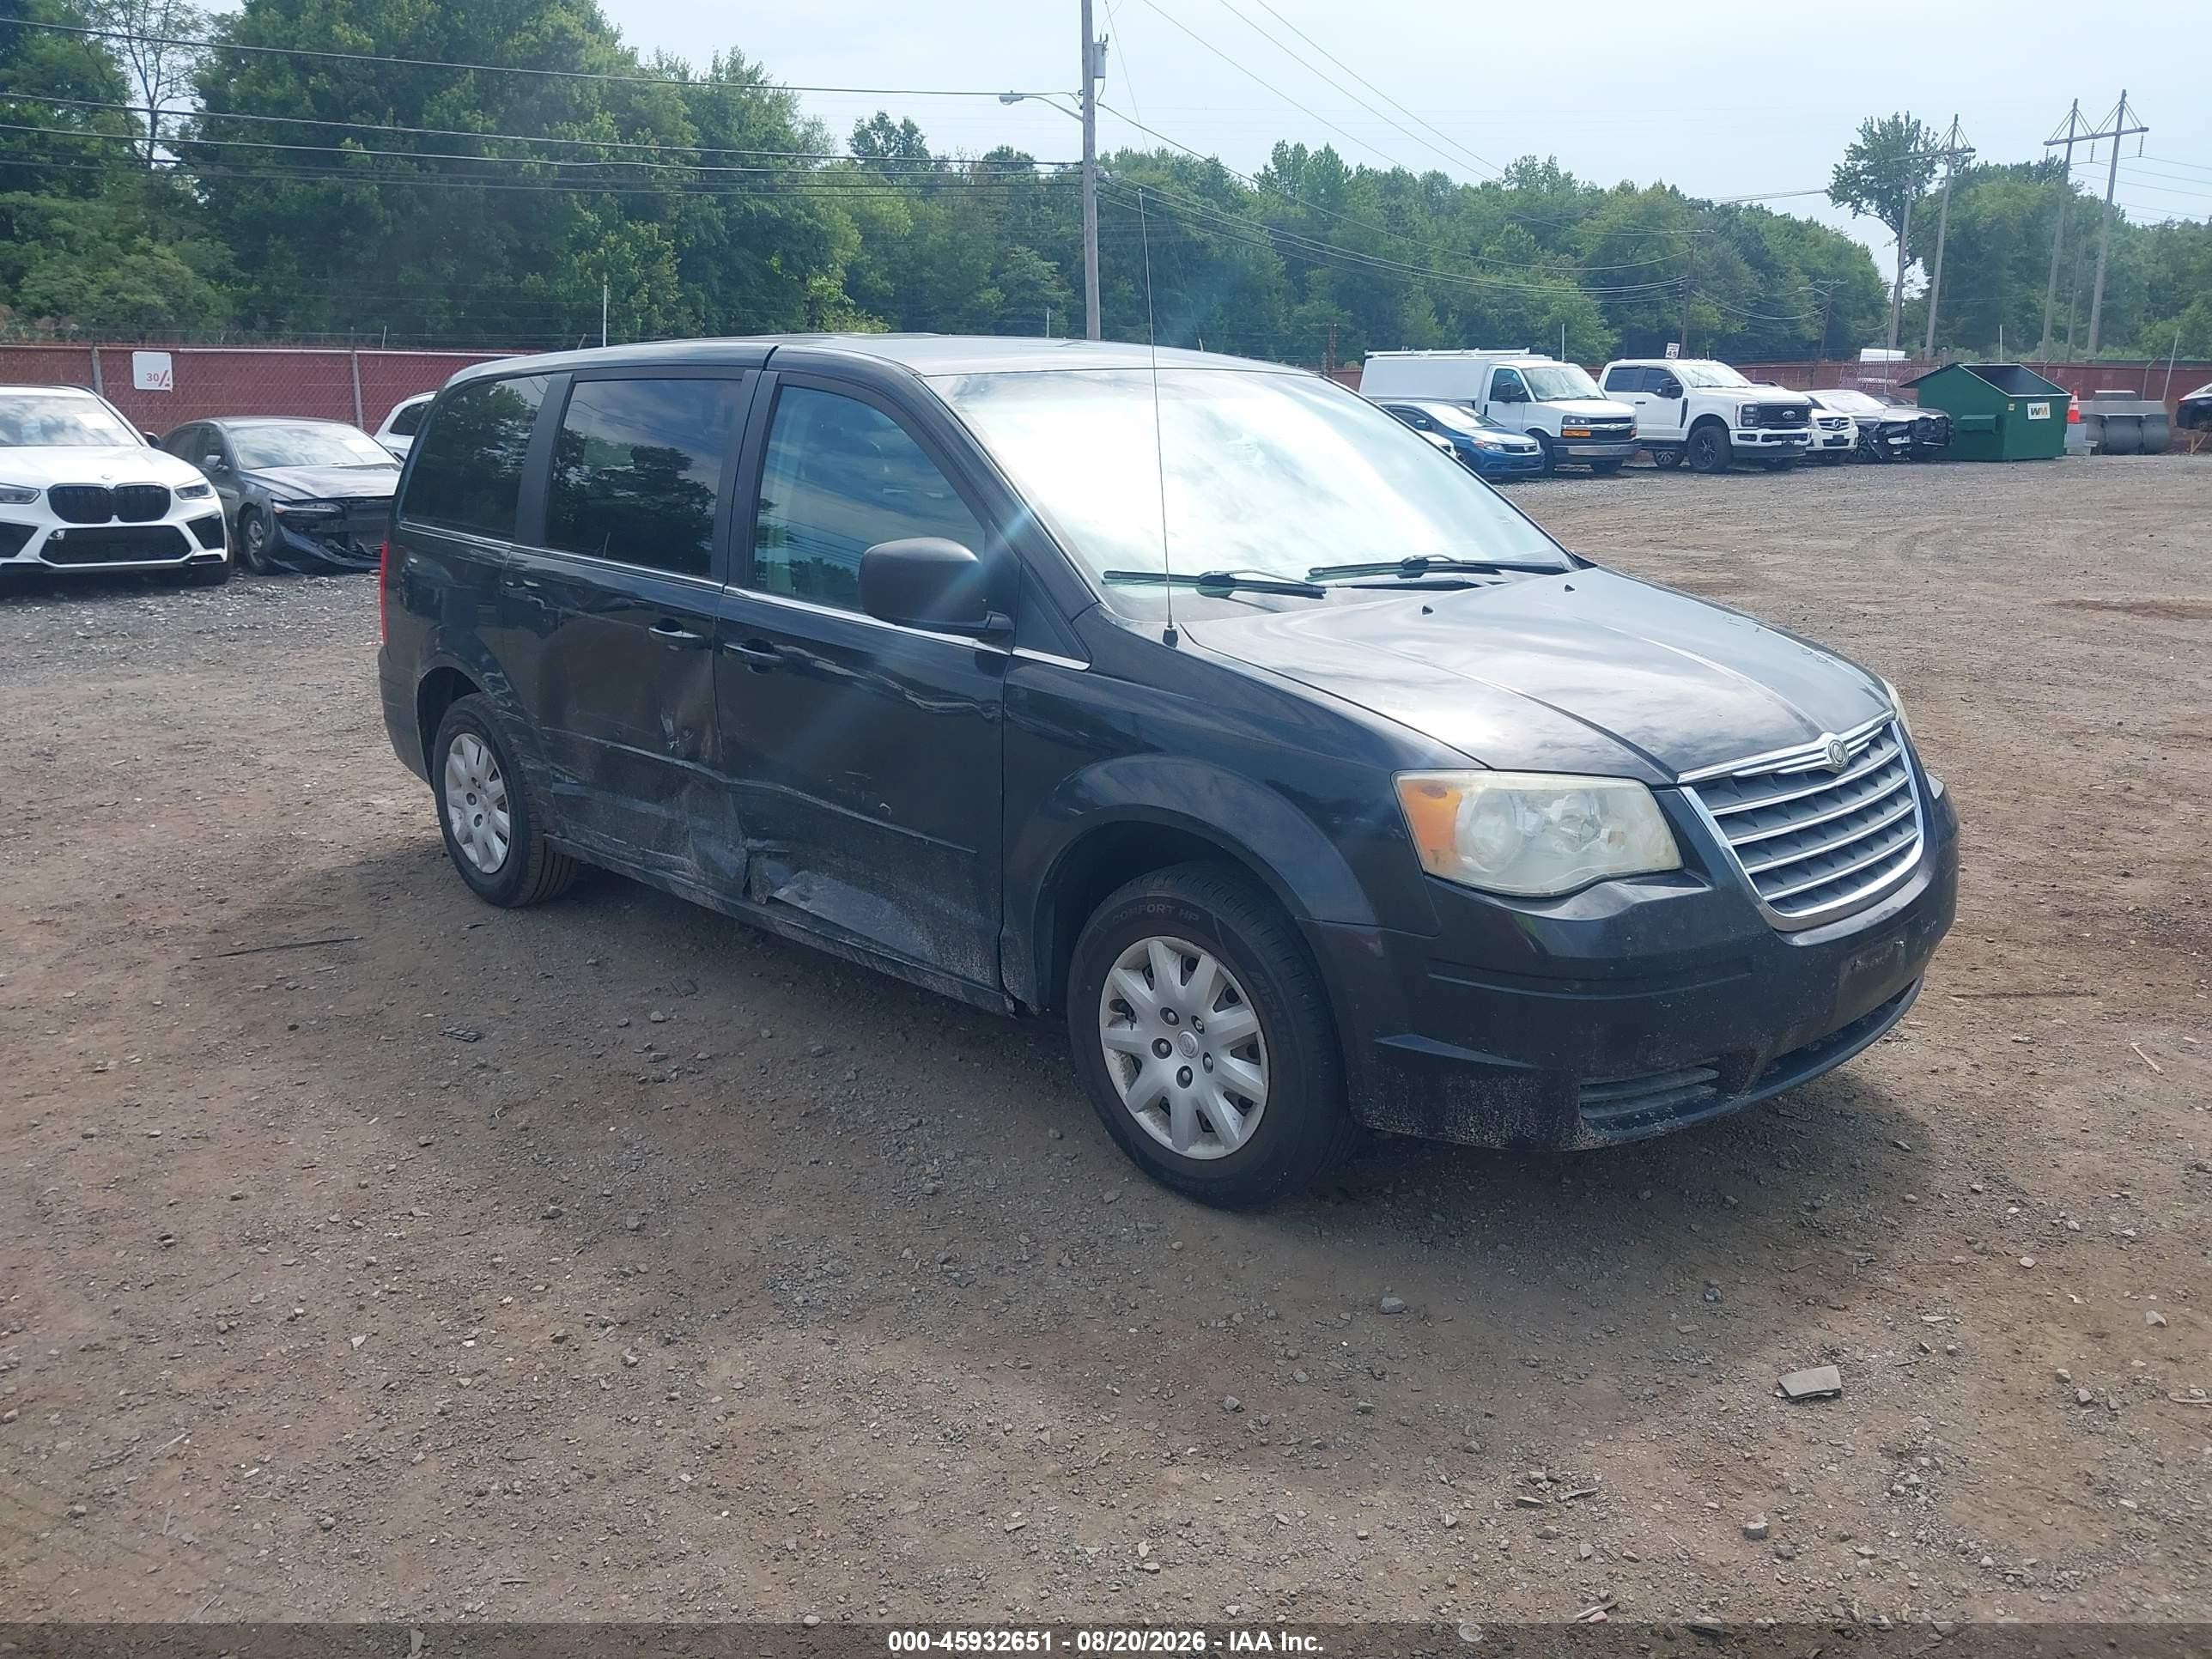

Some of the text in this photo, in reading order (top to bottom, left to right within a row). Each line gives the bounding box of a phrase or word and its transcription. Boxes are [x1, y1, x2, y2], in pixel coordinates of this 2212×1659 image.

[2031, 407, 2048, 416] WM
[1112, 904, 1200, 924] COMFORT HP
